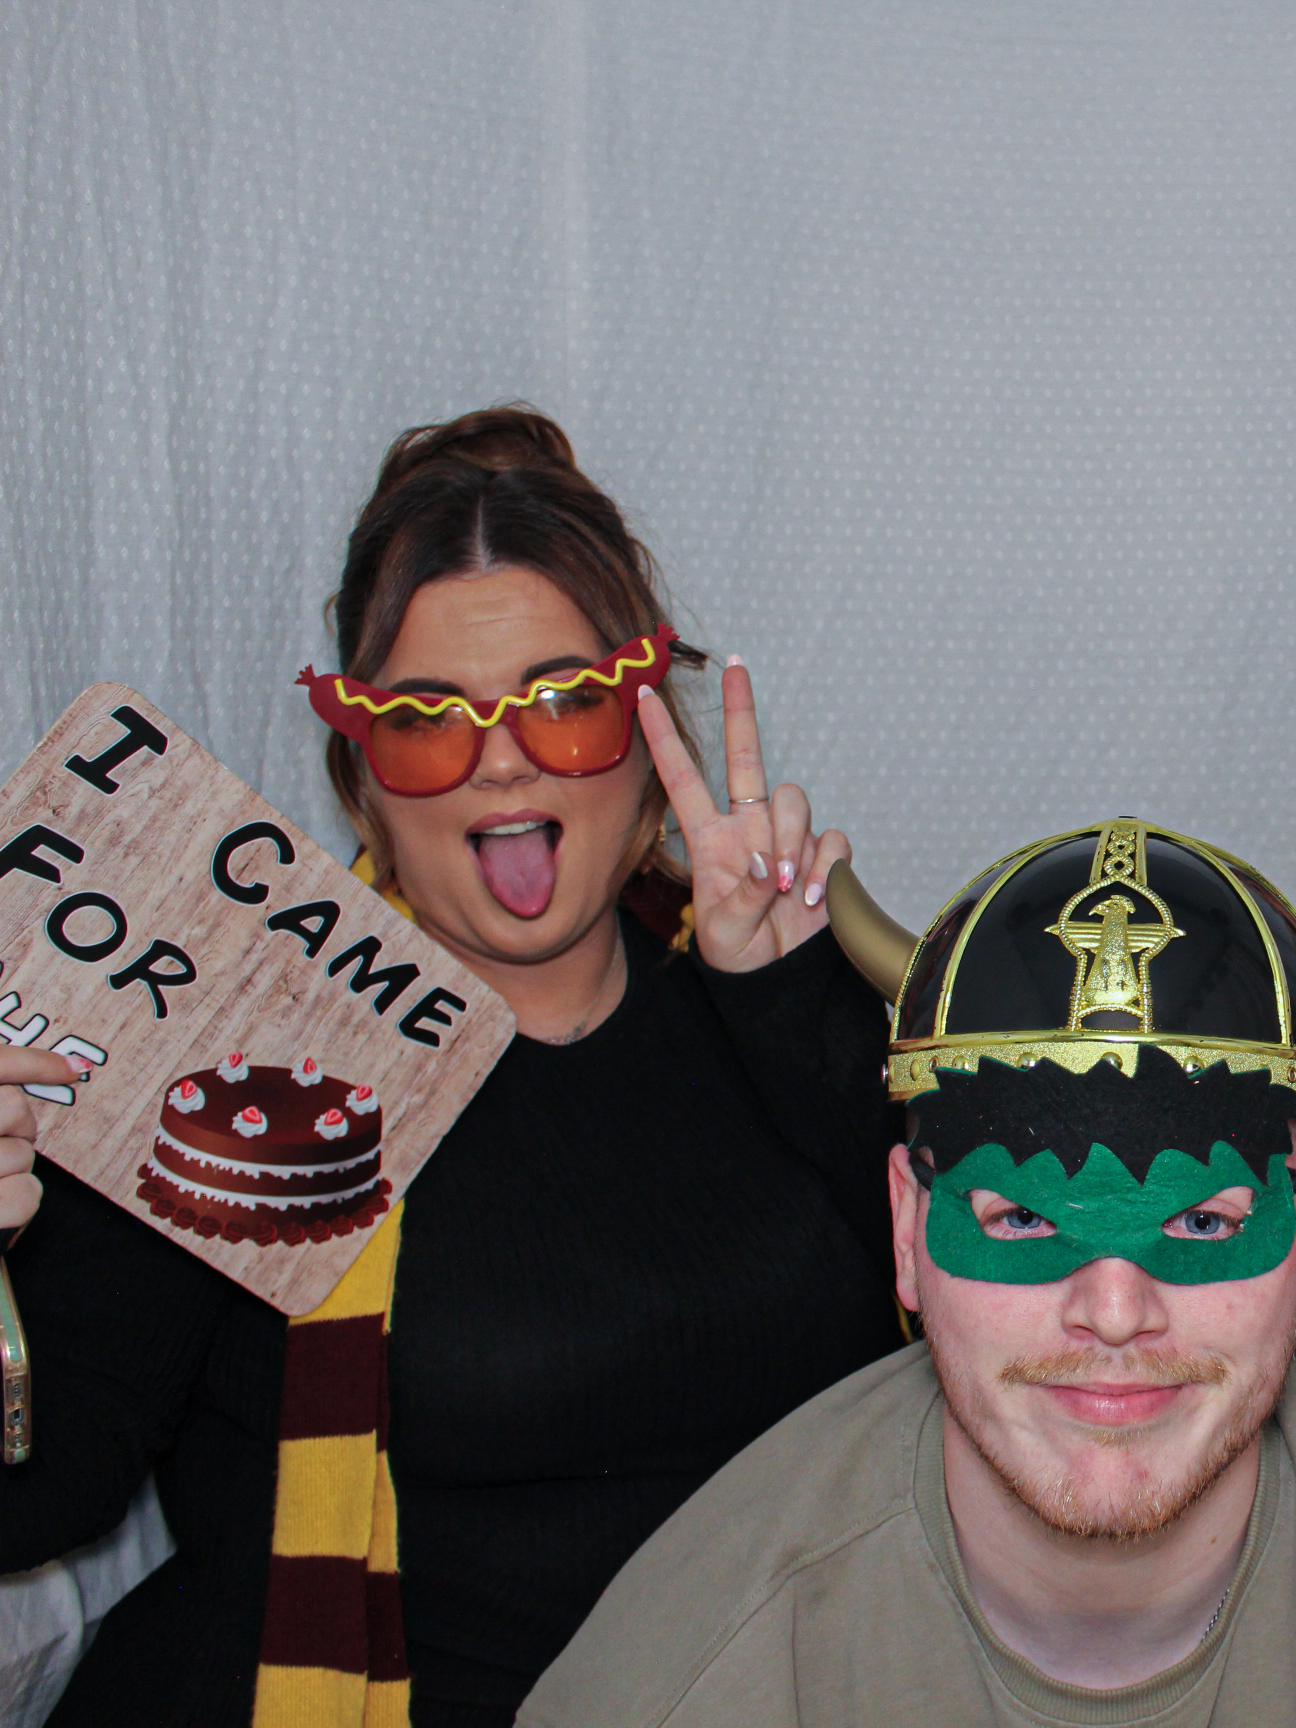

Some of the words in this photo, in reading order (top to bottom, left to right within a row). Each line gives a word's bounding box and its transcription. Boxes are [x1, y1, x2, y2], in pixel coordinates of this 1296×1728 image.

[0, 823, 198, 1020] FOR
[63, 704, 169, 795] I
[210, 820, 468, 1049] CAME
